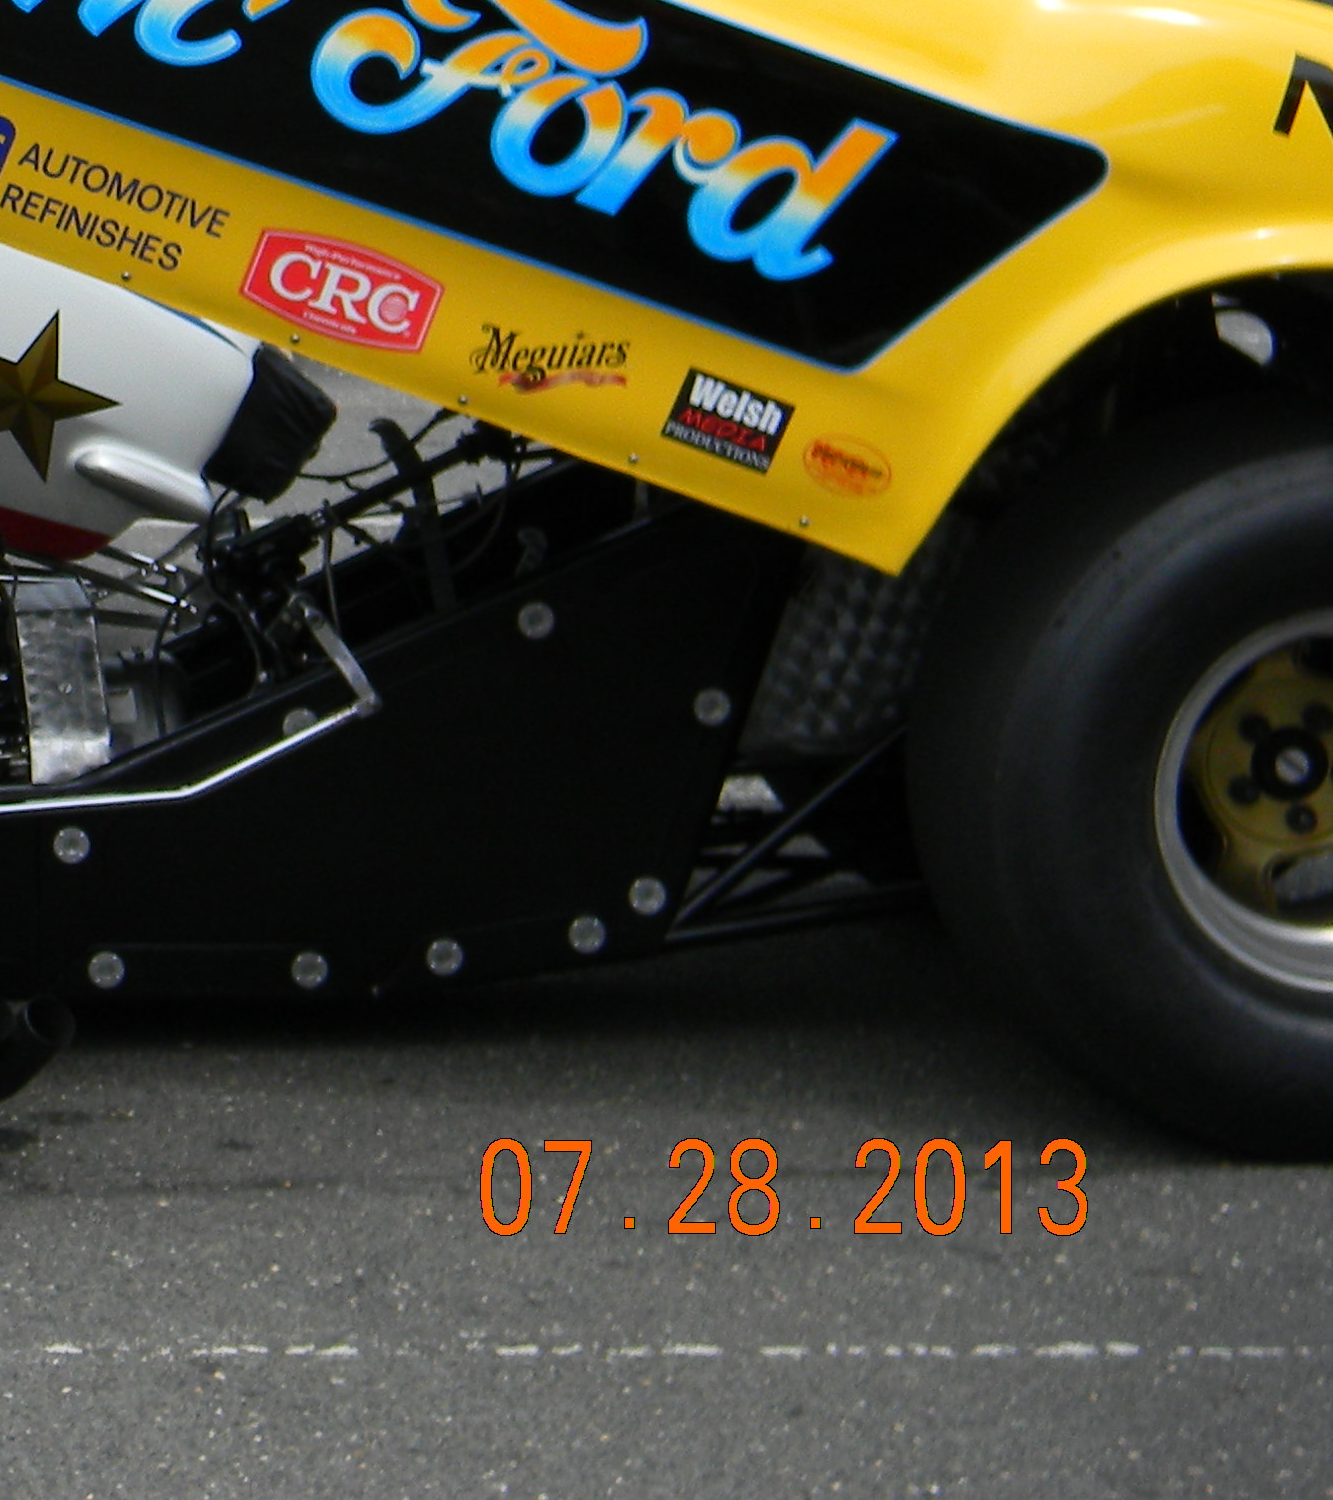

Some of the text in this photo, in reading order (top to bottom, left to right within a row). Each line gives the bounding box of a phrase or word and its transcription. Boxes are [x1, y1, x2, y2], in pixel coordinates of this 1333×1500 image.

[0, 182, 183, 274] REFINISHES
[17, 143, 231, 240] AUTOMOTIVE
[269, 251, 421, 334] CRC
[678, 408, 767, 451] MEDIA
[689, 372, 784, 436] Welsh
[664, 421, 771, 471] PRODUCTIONS
